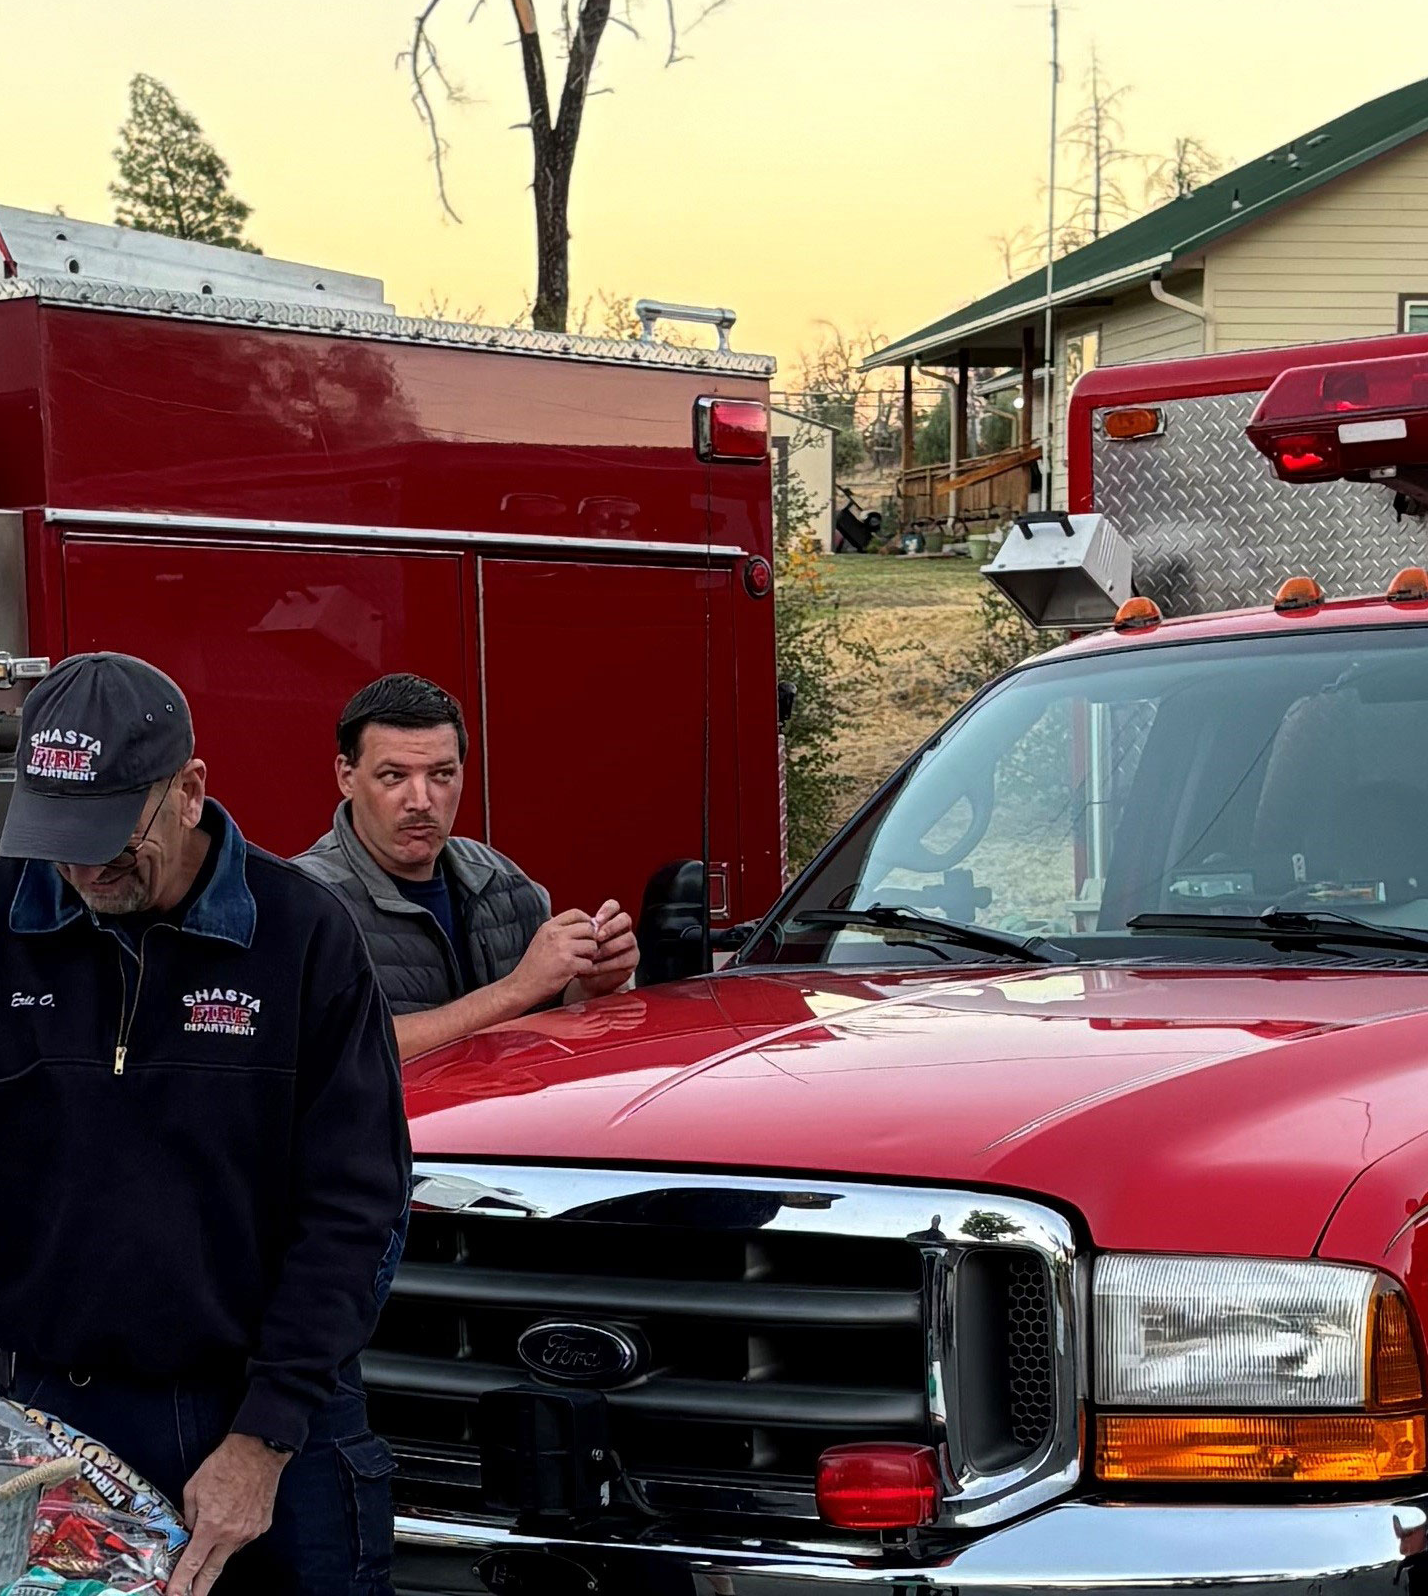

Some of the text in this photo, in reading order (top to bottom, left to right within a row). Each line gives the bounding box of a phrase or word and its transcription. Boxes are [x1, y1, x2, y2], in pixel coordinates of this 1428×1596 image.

[30, 728, 102, 756] SHASTA
[31, 746, 93, 772] FIRE
[26, 764, 98, 782] DEPARTMENT
[181, 987, 261, 1014] SHASTA
[190, 1004, 253, 1027] FIRE
[183, 1022, 257, 1036] DEPARTMENT
[541, 1333, 603, 1367] Ford
